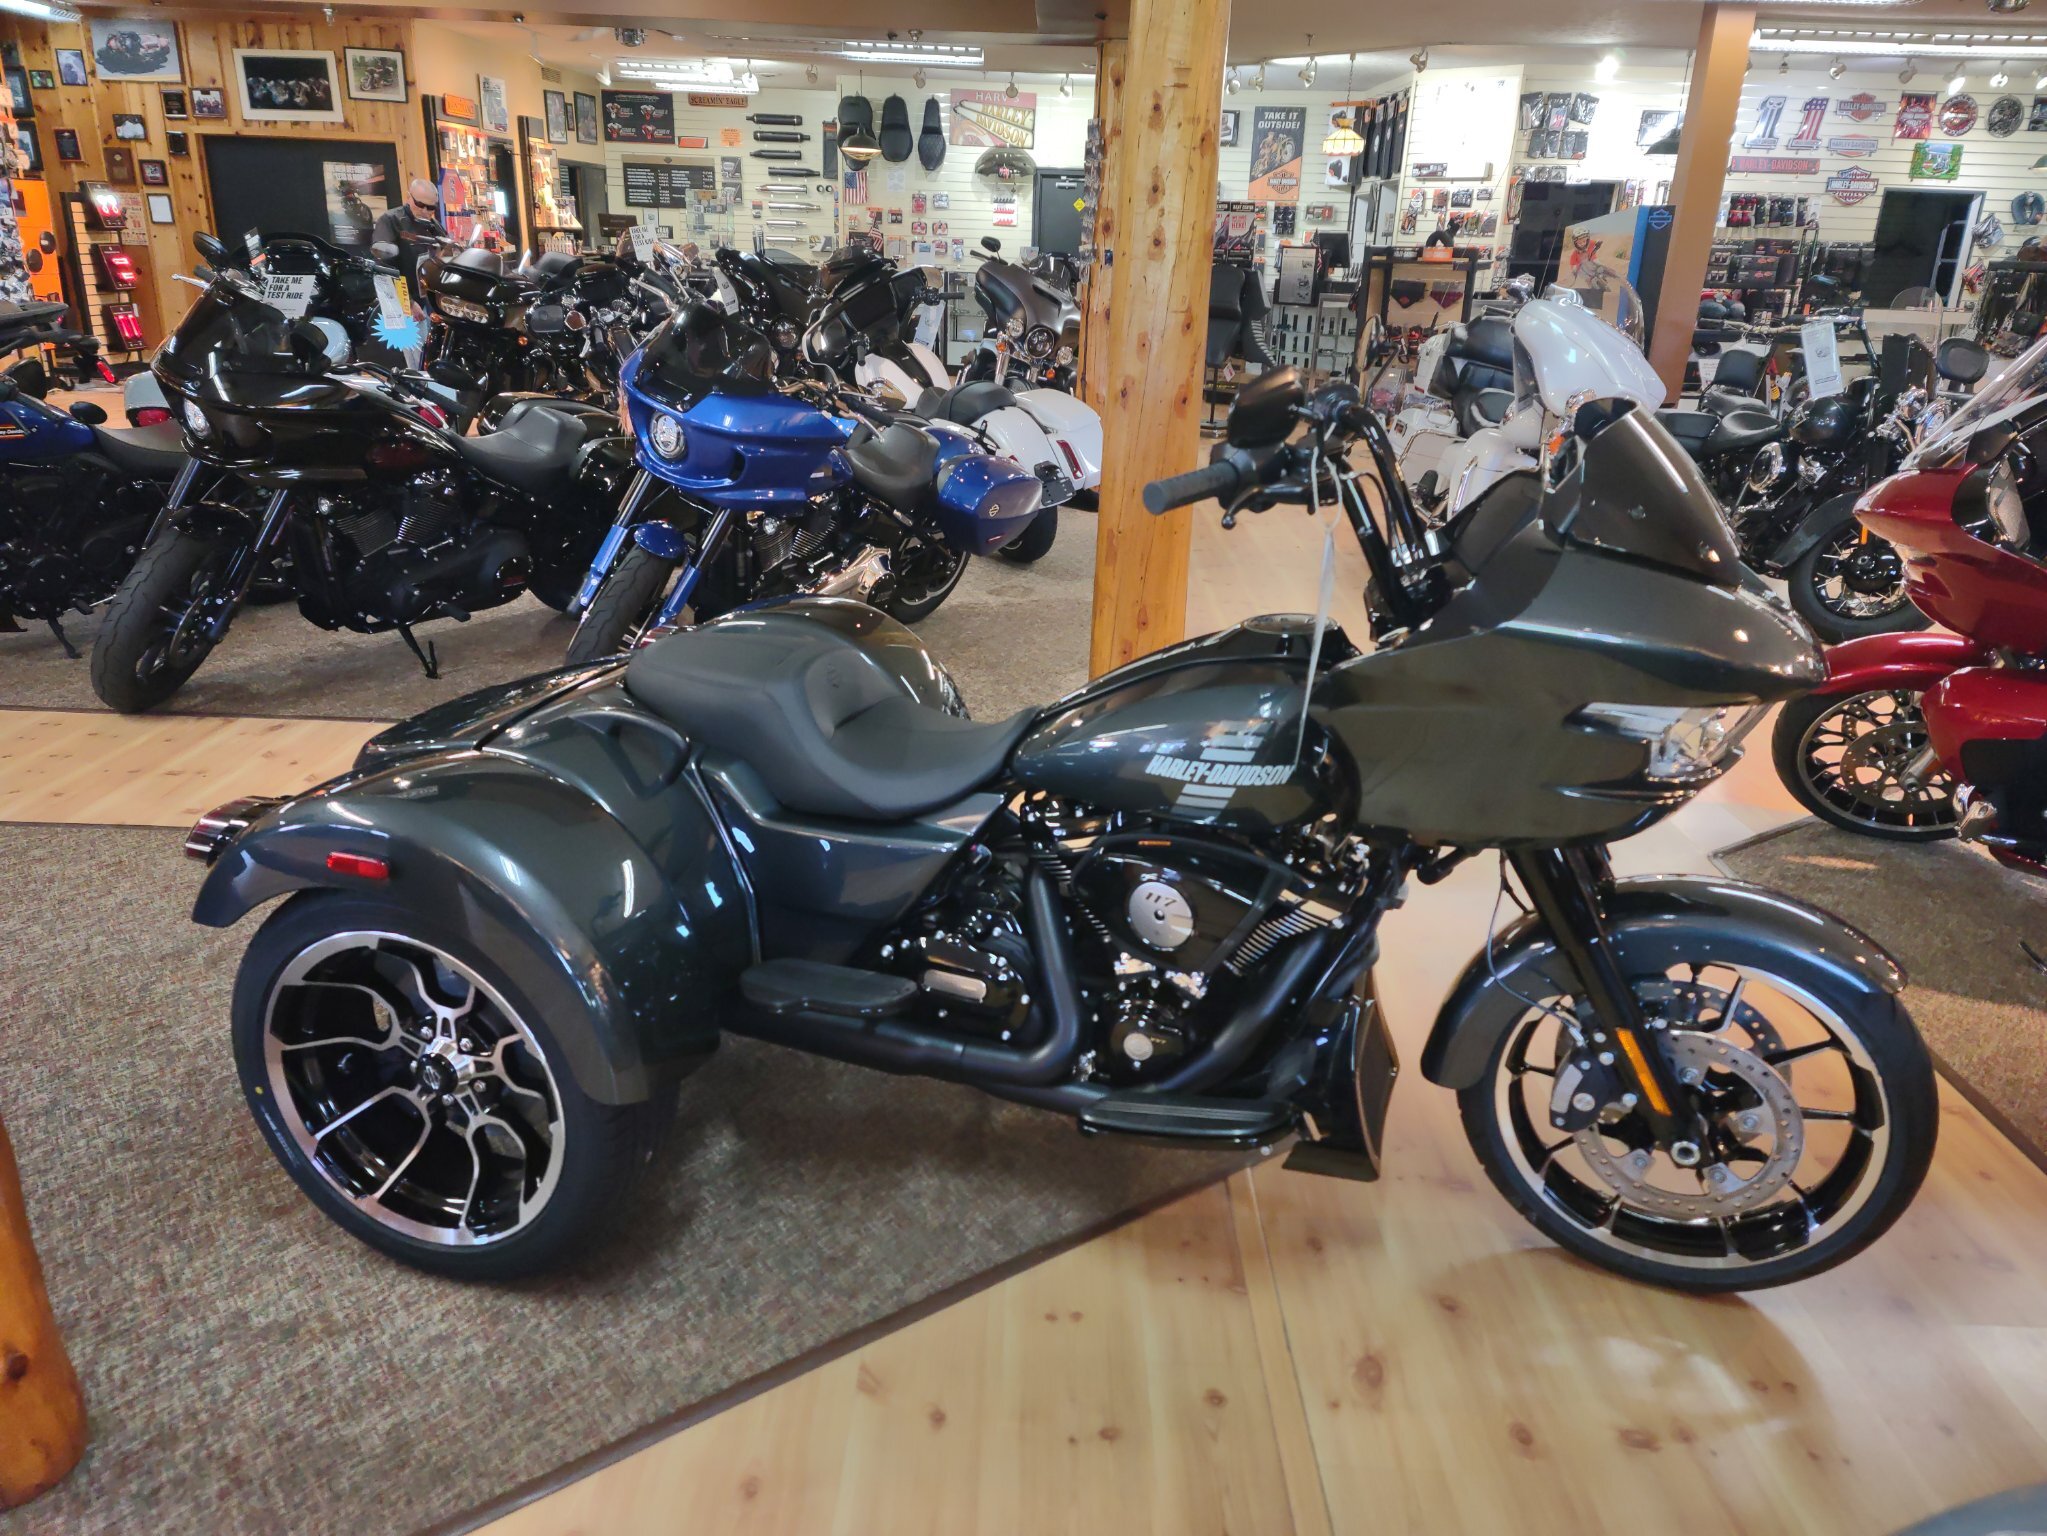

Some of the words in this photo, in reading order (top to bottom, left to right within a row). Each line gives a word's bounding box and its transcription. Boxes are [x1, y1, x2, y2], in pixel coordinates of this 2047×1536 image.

[981, 105, 1031, 126] HARLEY
[1264, 112, 1286, 120] TAKE
[1289, 112, 1298, 120] IT
[976, 114, 1029, 147] DAVIDSON
[1258, 121, 1300, 129] OUTSIDE!
[272, 276, 290, 284] TAKE
[291, 276, 304, 284] ME
[267, 291, 286, 299] TEST
[1145, 754, 1296, 786] HARLEY-DAVIDSON
[1146, 892, 1177, 907] 117
